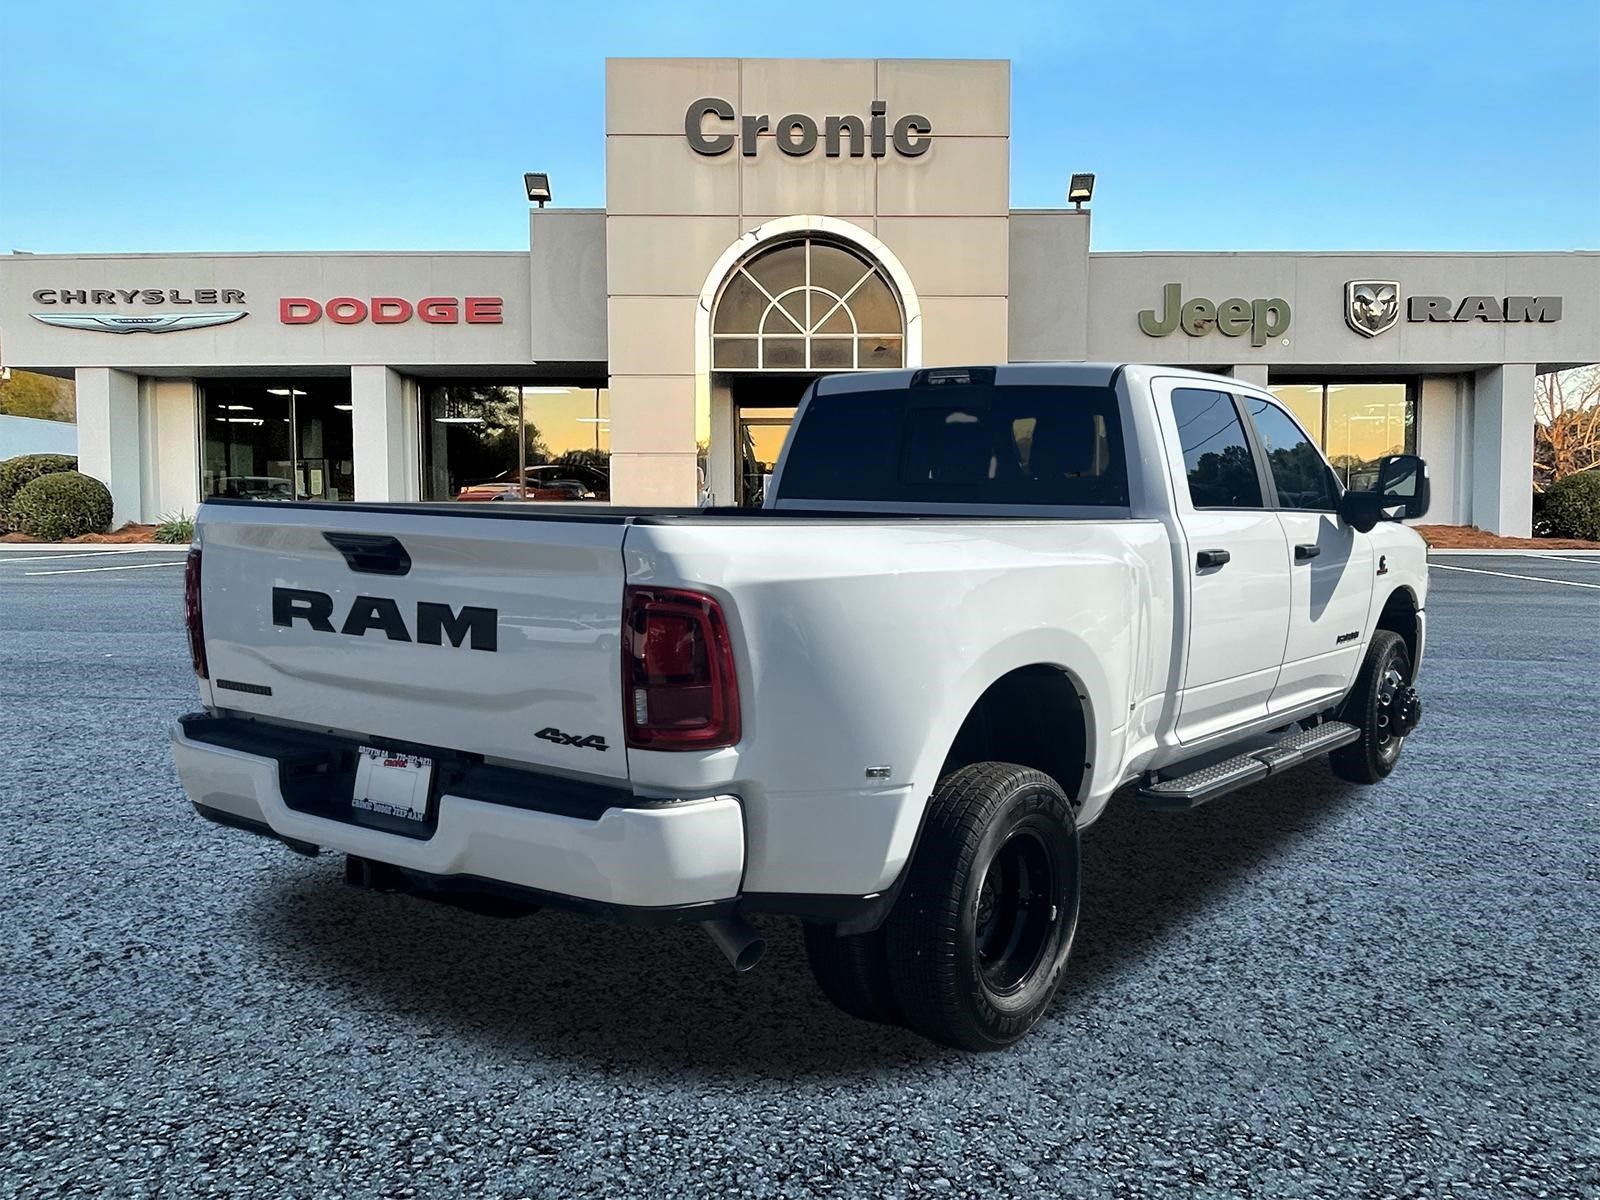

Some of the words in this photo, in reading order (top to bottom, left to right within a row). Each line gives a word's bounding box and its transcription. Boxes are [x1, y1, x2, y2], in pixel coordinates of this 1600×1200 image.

[684, 97, 932, 157] Cronic
[32, 289, 247, 304] CHRYSLER
[280, 297, 503, 324] DODGE
[1138, 283, 1292, 346] Jeep
[1407, 296, 1563, 322] RAM
[272, 586, 498, 652] RAM
